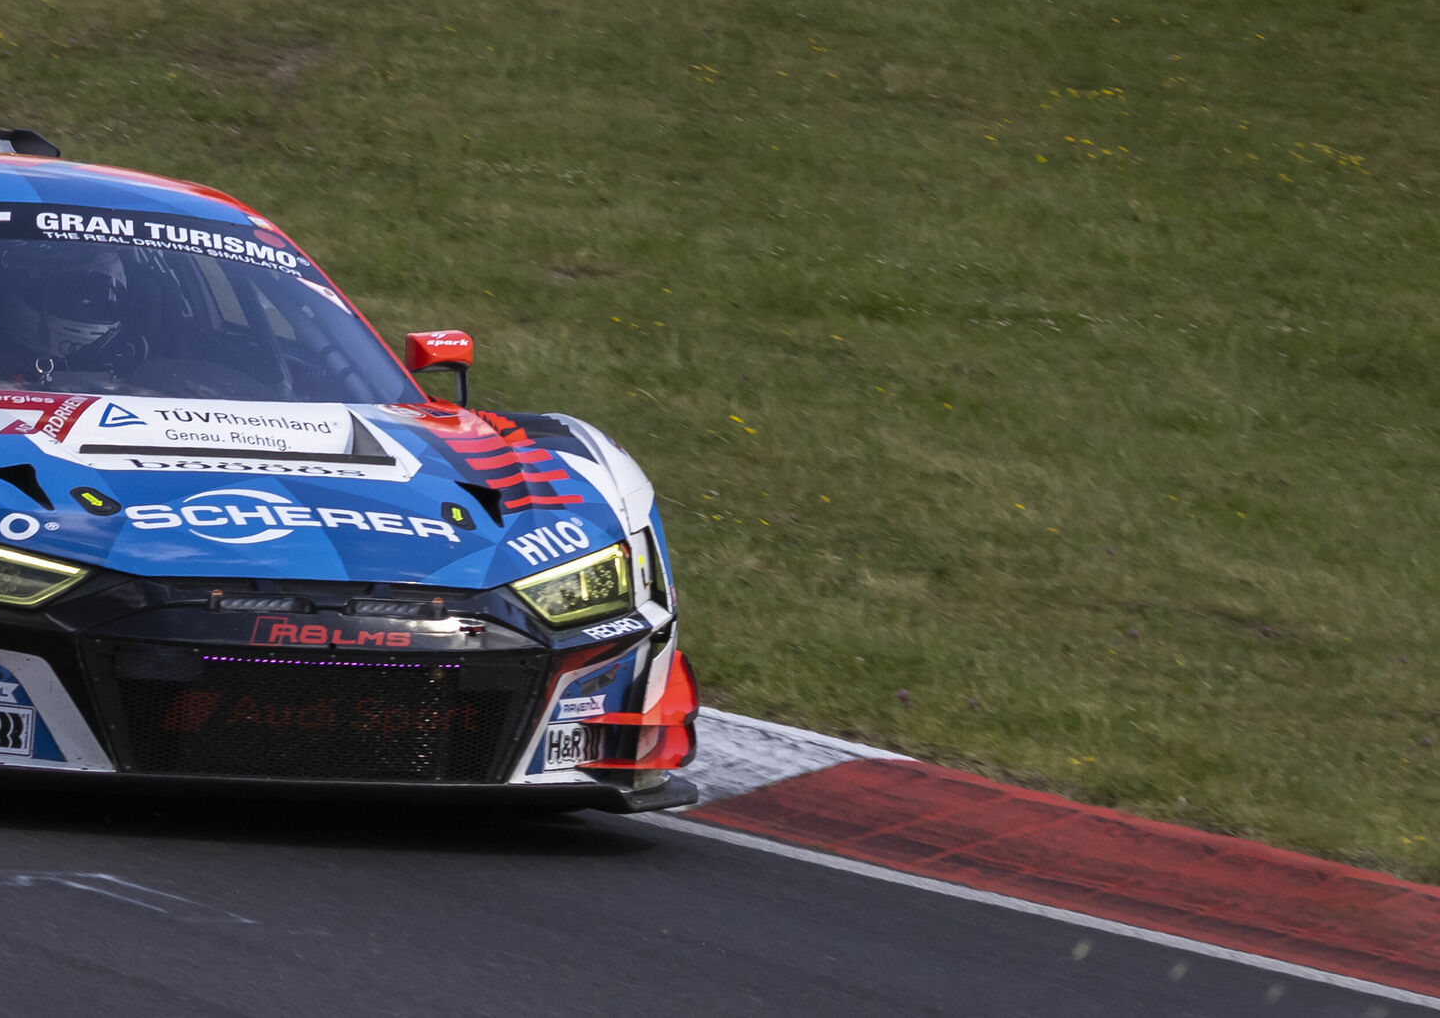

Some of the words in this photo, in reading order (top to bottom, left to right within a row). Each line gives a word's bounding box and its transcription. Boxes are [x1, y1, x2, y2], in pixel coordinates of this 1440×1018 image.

[35, 212, 135, 237] GRAN
[42, 231, 81, 241] THE
[83, 234, 130, 245] REAL
[132, 238, 203, 255] DRIVING
[205, 248, 303, 278] SIMULATOR
[164, 428, 226, 444] Genau.
[231, 431, 292, 452] Richtig.
[124, 503, 462, 544] SCHERER
[331, 629, 411, 647] LMS
[226, 695, 337, 729] Audi
[352, 697, 481, 738] Sport
